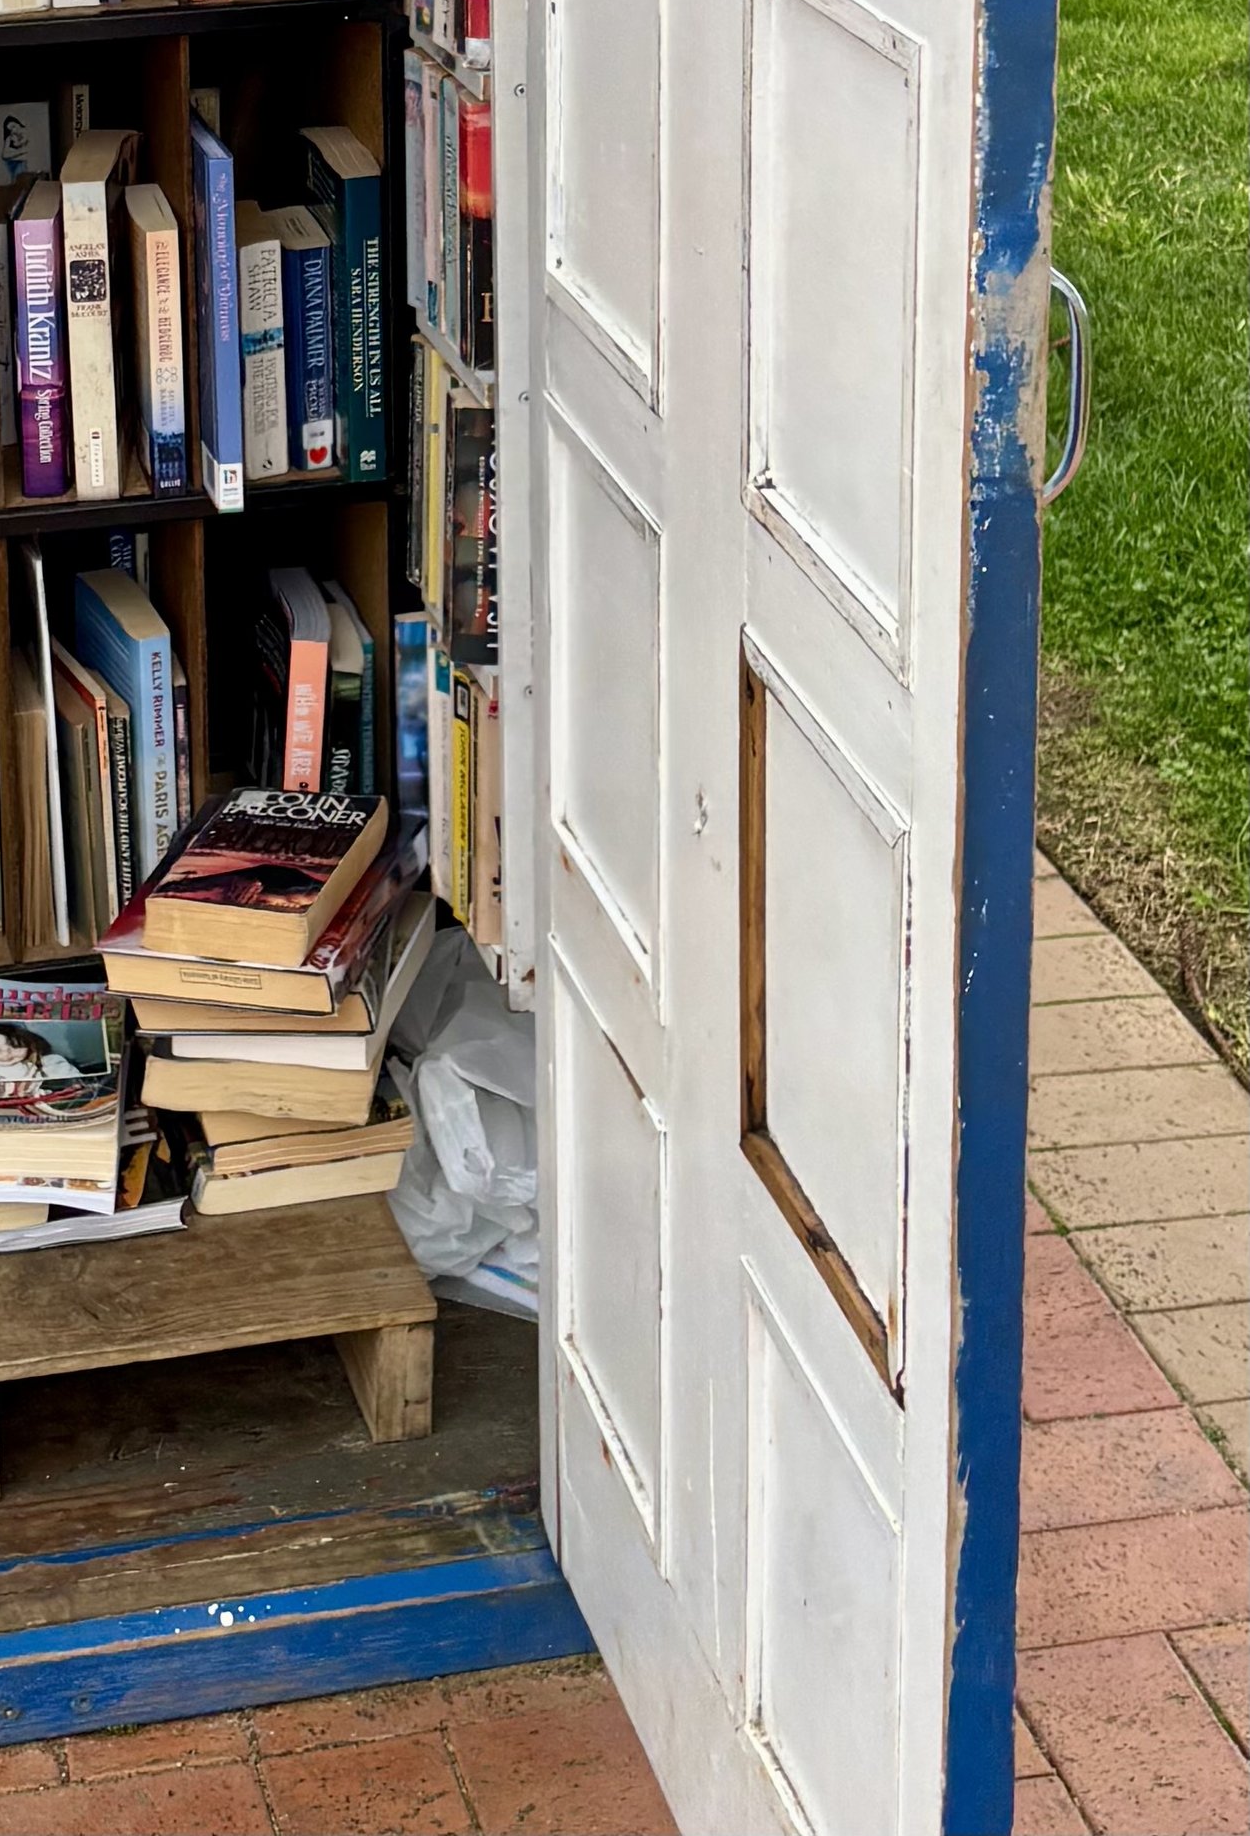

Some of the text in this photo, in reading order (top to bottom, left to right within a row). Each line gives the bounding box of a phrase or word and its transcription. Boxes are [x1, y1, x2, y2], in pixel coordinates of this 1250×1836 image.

[21, 230, 56, 384] Judith Krantz
[247, 263, 263, 313] SHAW
[260, 247, 279, 323] PATRICIA
[304, 259, 323, 309] DIANA
[306, 310, 325, 370] PALMER
[350, 267, 364, 393] SARA HENDERSON
[366, 236, 382, 418] THE STRENGTH IN US ALL
[150, 650, 166, 748] KELLY RIMMER
[154, 770, 169, 820] PARIS
[223, 803, 368, 827] FALCONER
[265, 792, 350, 811] COLIN
